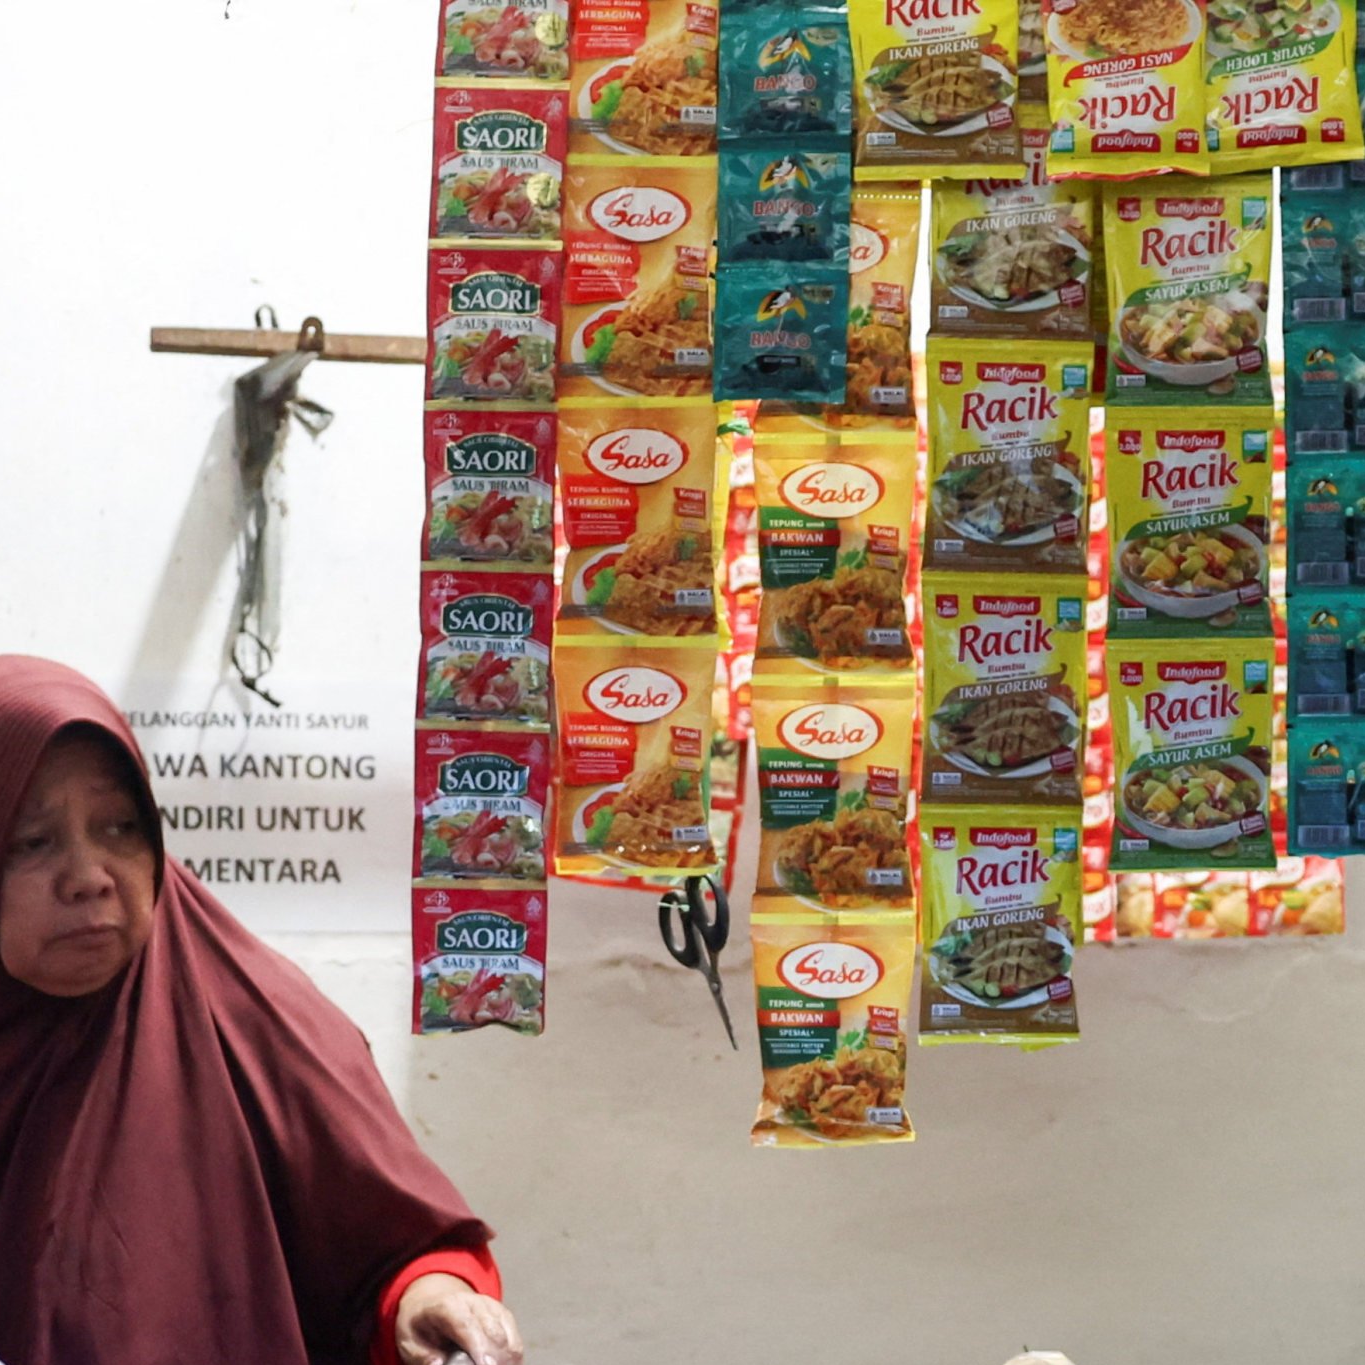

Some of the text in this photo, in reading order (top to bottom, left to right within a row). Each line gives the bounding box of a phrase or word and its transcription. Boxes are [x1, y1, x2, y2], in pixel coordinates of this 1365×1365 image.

[889, 37, 980, 61] IKAN GORENG
[1225, 42, 1315, 72] SAYUR LODEH
[1083, 51, 1173, 76] NASI GORENG
[754, 72, 817, 92] BANO
[1078, 85, 1176, 130] Racik
[1221, 76, 1319, 126] Racik
[462, 126, 537, 148] SAORI
[1098, 136, 1154, 148] Indofood
[1243, 127, 1299, 144] Indofood
[604, 193, 676, 228] Sasa
[965, 210, 1057, 232] IKAN GORENG
[1141, 220, 1239, 266] Racik
[457, 288, 531, 310] SAORI
[1145, 280, 1229, 302] SAYUR ASEM
[961, 386, 1059, 431] Racik
[452, 449, 527, 471] SAORI
[600, 435, 674, 471] Sasa
[962, 445, 1052, 466] IKAN GORENG
[796, 469, 869, 505] Sasa
[1141, 452, 1239, 500] Racik
[1145, 512, 1230, 534] SAYUR ASEM
[771, 532, 824, 542] BAKWAN
[448, 608, 524, 632] SAORI
[958, 619, 1053, 664] Racik
[600, 673, 673, 709] Sasa
[959, 678, 1048, 699] IKAN GORENG
[1145, 684, 1241, 731] Racik
[243, 711, 300, 729] YANTI
[306, 712, 369, 730] SAYUR
[794, 711, 869, 746] Sasa
[149, 753, 377, 780] WA KANTONG
[1148, 742, 1232, 767] SAYUR ASEM
[445, 768, 519, 791] SAORI
[771, 774, 823, 784] BAKWAN
[159, 805, 366, 833] NDIRI UNTUK
[976, 832, 1031, 844] Indofood
[184, 857, 342, 884] MENTARA
[956, 849, 1050, 896] Racik
[956, 908, 1045, 931] IKAN GORENG
[443, 927, 517, 949] SAORI
[795, 950, 870, 986] Sasa
[771, 1012, 824, 1023] BAKWAN
